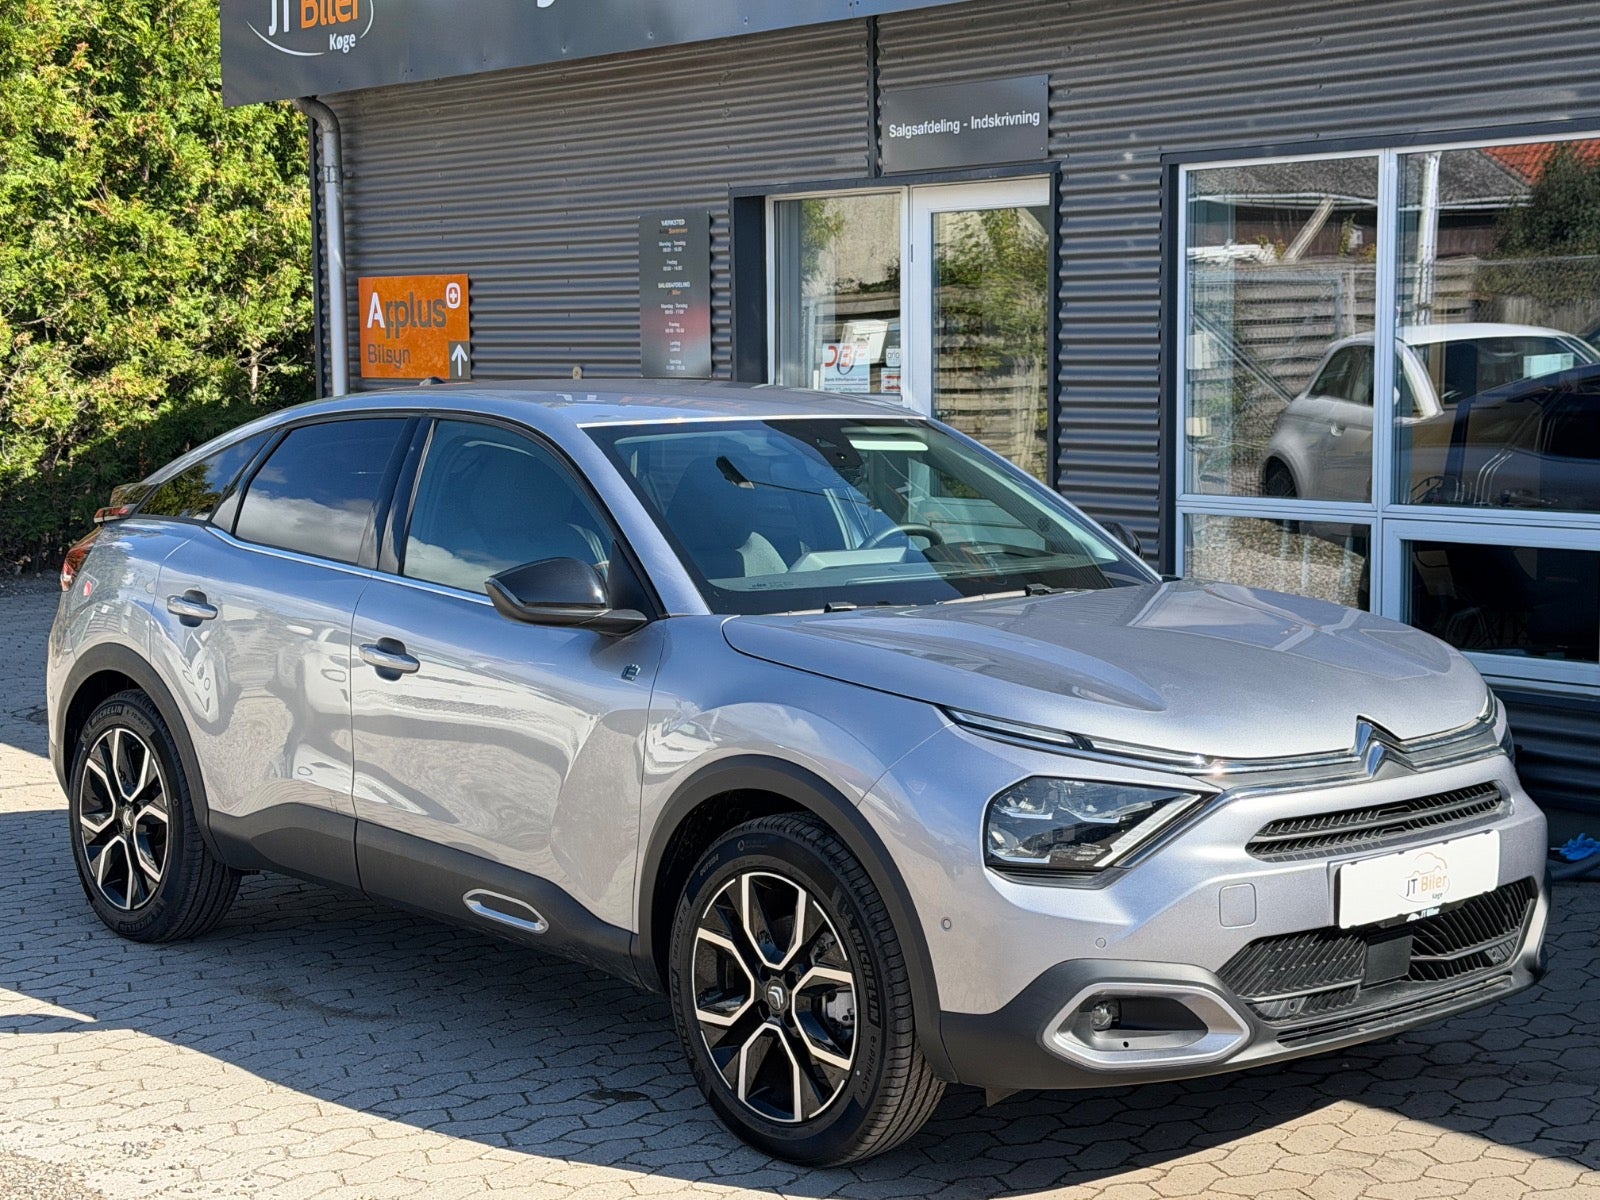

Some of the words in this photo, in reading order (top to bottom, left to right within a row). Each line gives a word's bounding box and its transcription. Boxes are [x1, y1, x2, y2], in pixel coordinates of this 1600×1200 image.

[329, 33, 356, 53] Køge
[889, 119, 960, 139] Salgsafdeling
[971, 110, 1040, 129] Indskrivning
[367, 343, 411, 369] Bilsyn
[1406, 878, 1418, 897] JT
[1421, 874, 1447, 892] Biler
[850, 928, 881, 1024] MICHELIN
